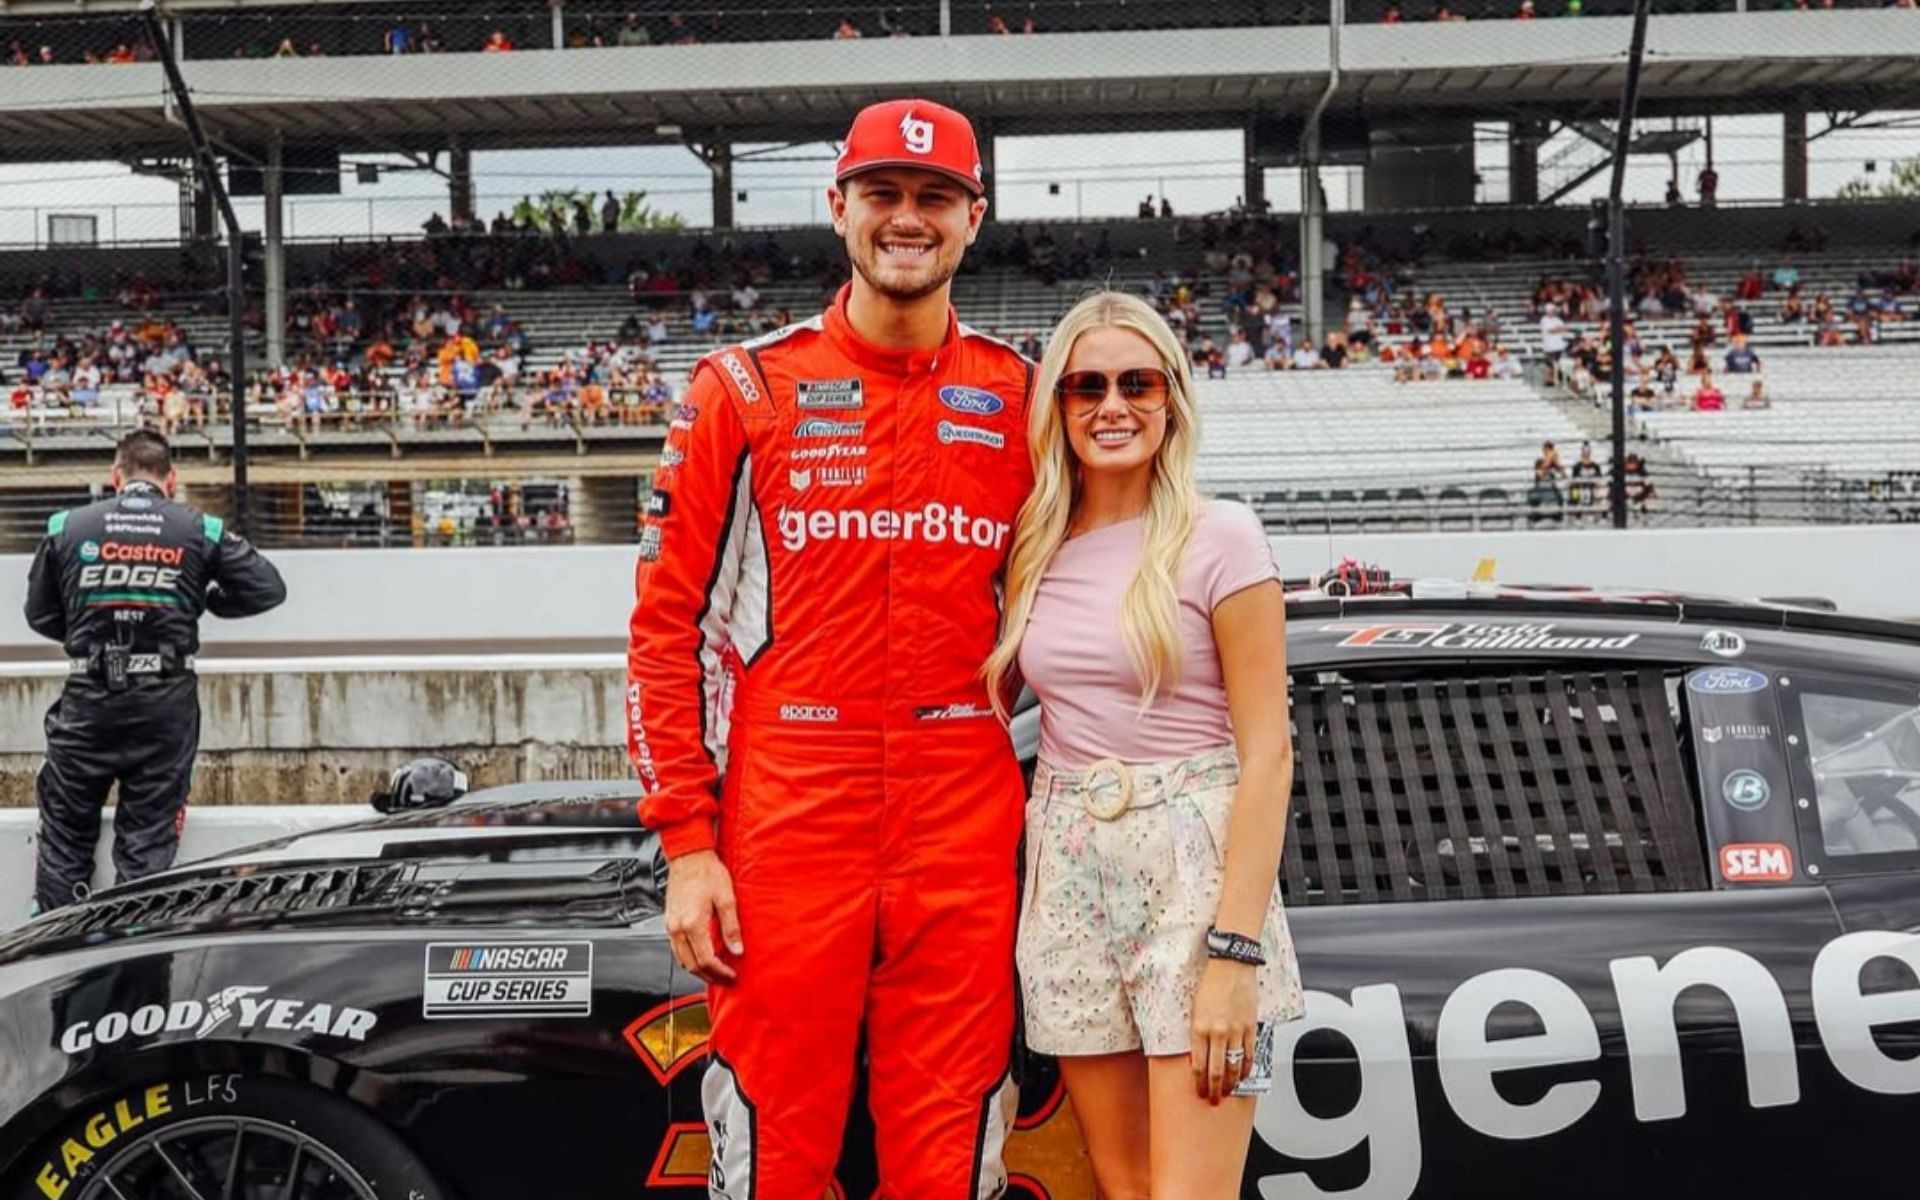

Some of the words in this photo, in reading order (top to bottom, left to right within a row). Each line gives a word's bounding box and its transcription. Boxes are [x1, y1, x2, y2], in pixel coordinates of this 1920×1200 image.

[902, 110, 934, 154] g
[791, 444, 867, 460] GOODYEAR
[777, 502, 1010, 552] gener8tor
[101, 541, 184, 565] Castrol
[79, 564, 182, 589] EDGE
[1431, 633, 1640, 649] Gilliland
[1704, 671, 1753, 690] Ford
[780, 704, 838, 721] sparco
[1725, 848, 1788, 876] SEM
[478, 948, 569, 970] NASCAR
[447, 981, 492, 1001] CUP
[493, 979, 570, 1001] SERIES
[35, 1083, 173, 1200] EAGLE
